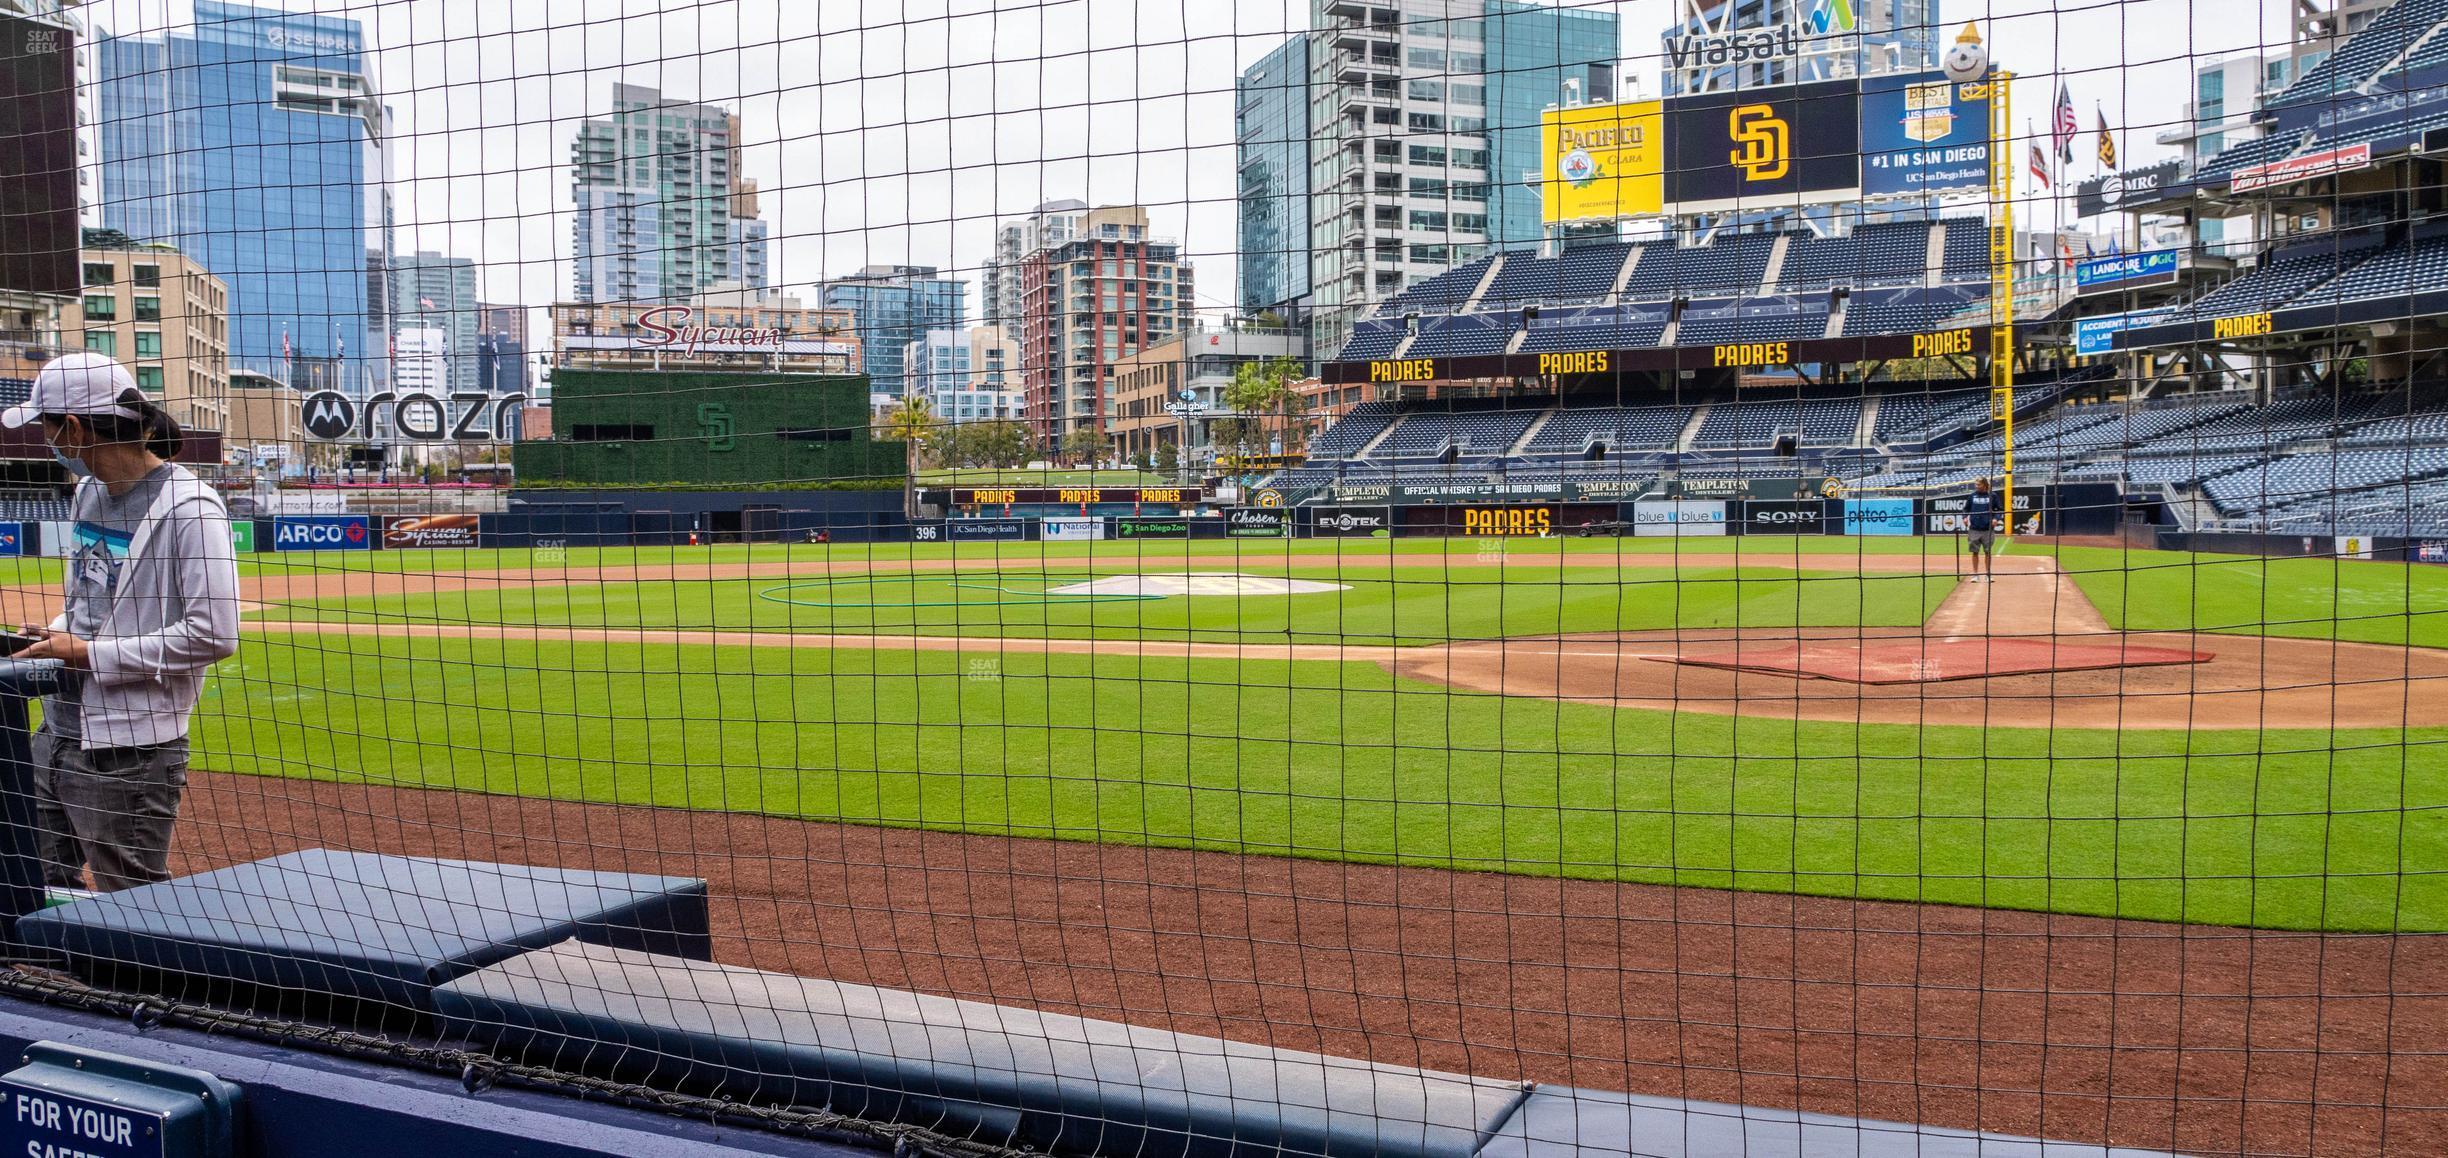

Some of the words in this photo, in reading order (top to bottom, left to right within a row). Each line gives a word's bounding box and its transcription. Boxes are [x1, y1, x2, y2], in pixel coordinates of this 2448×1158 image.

[294, 34, 356, 51] SEMPRA
[1664, 24, 1798, 69] Viasat
[1909, 85, 1947, 99] BEST
[1908, 97, 1948, 107] HOSPITALS
[1730, 104, 1789, 181] SD
[1872, 156, 1889, 168] #1
[1894, 154, 1908, 167] IN
[1913, 151, 1941, 165] SAN
[1946, 147, 1986, 162] DIEGO
[1906, 174, 1919, 182] UC
[1920, 173, 1935, 181] San
[1936, 171, 1958, 181] Diego
[1960, 168, 1985, 177] Health
[2125, 174, 2158, 190] MRC
[2093, 259, 2140, 275] LANDCARE
[2144, 252, 2175, 267] LOGIC
[636, 306, 783, 358] Sycuan
[2214, 312, 2273, 339] PADRES
[1913, 328, 1972, 357] PADRES
[1714, 342, 1788, 367] PADRES
[1540, 351, 1608, 374] PADRES
[1370, 359, 1434, 382] PADRES
[1163, 402, 1209, 411] Gallagher
[363, 390, 528, 440] razr
[697, 403, 735, 451] SD
[1333, 486, 1389, 496] TEMPLETON
[1405, 487, 1439, 495] OFFICIAL
[1440, 486, 1476, 494] WHISKEY
[1495, 485, 1509, 493] SAN
[1512, 485, 1532, 493] DIEGO
[1534, 484, 1562, 492] PADRES
[1576, 482, 1641, 492] TEMPLETON
[1682, 480, 1749, 491] TEMPLETON
[974, 491, 1015, 503] PADRES
[1060, 490, 1100, 502] PADRES
[1142, 490, 1180, 501] PADRES
[2012, 496, 2029, 509] 322
[1231, 510, 1279, 523] Chosen
[1465, 508, 1550, 535] PADRES
[1637, 512, 1664, 522] blue
[1682, 511, 1709, 521] blue
[1757, 511, 1817, 523] SONY
[1848, 508, 1887, 526] petco
[389, 518, 471, 547] Sycuan
[978, 525, 996, 534] Diego
[996, 525, 1017, 533] Health
[1064, 522, 1099, 530] National
[1149, 525, 1170, 533] Diego
[278, 524, 343, 543] ARCO
[916, 527, 937, 540] 396
[17, 1094, 61, 1130] FOR
[67, 1105, 133, 1147] YOUR
